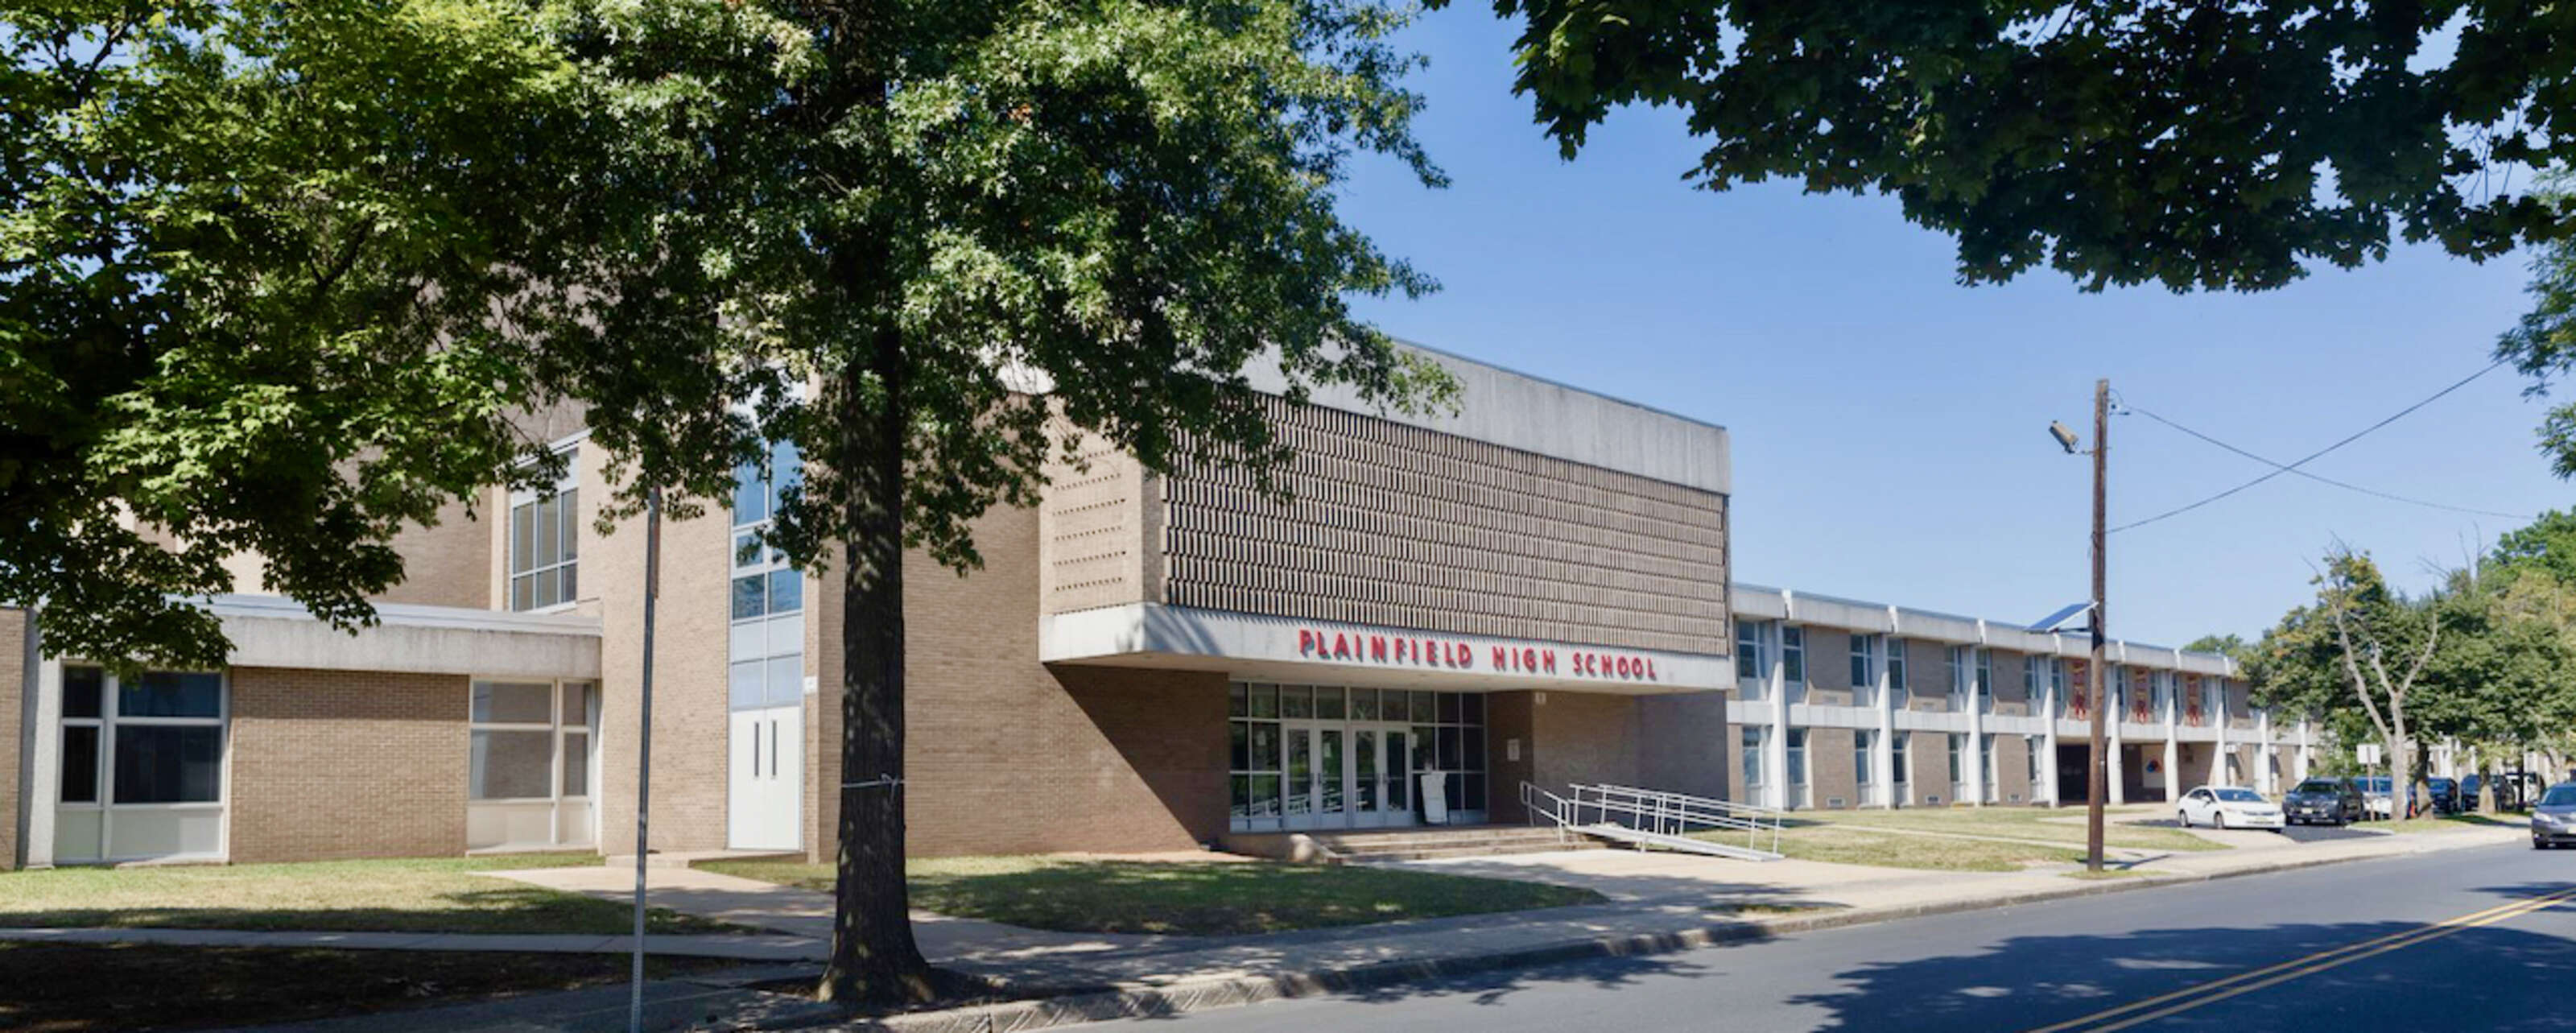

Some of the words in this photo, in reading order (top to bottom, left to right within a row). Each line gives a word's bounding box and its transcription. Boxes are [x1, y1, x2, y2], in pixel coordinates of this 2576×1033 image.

[1299, 630, 1471, 667] PLAINFIELD
[1492, 646, 1554, 673] HIGH
[1573, 651, 1656, 679] SCHOOL
